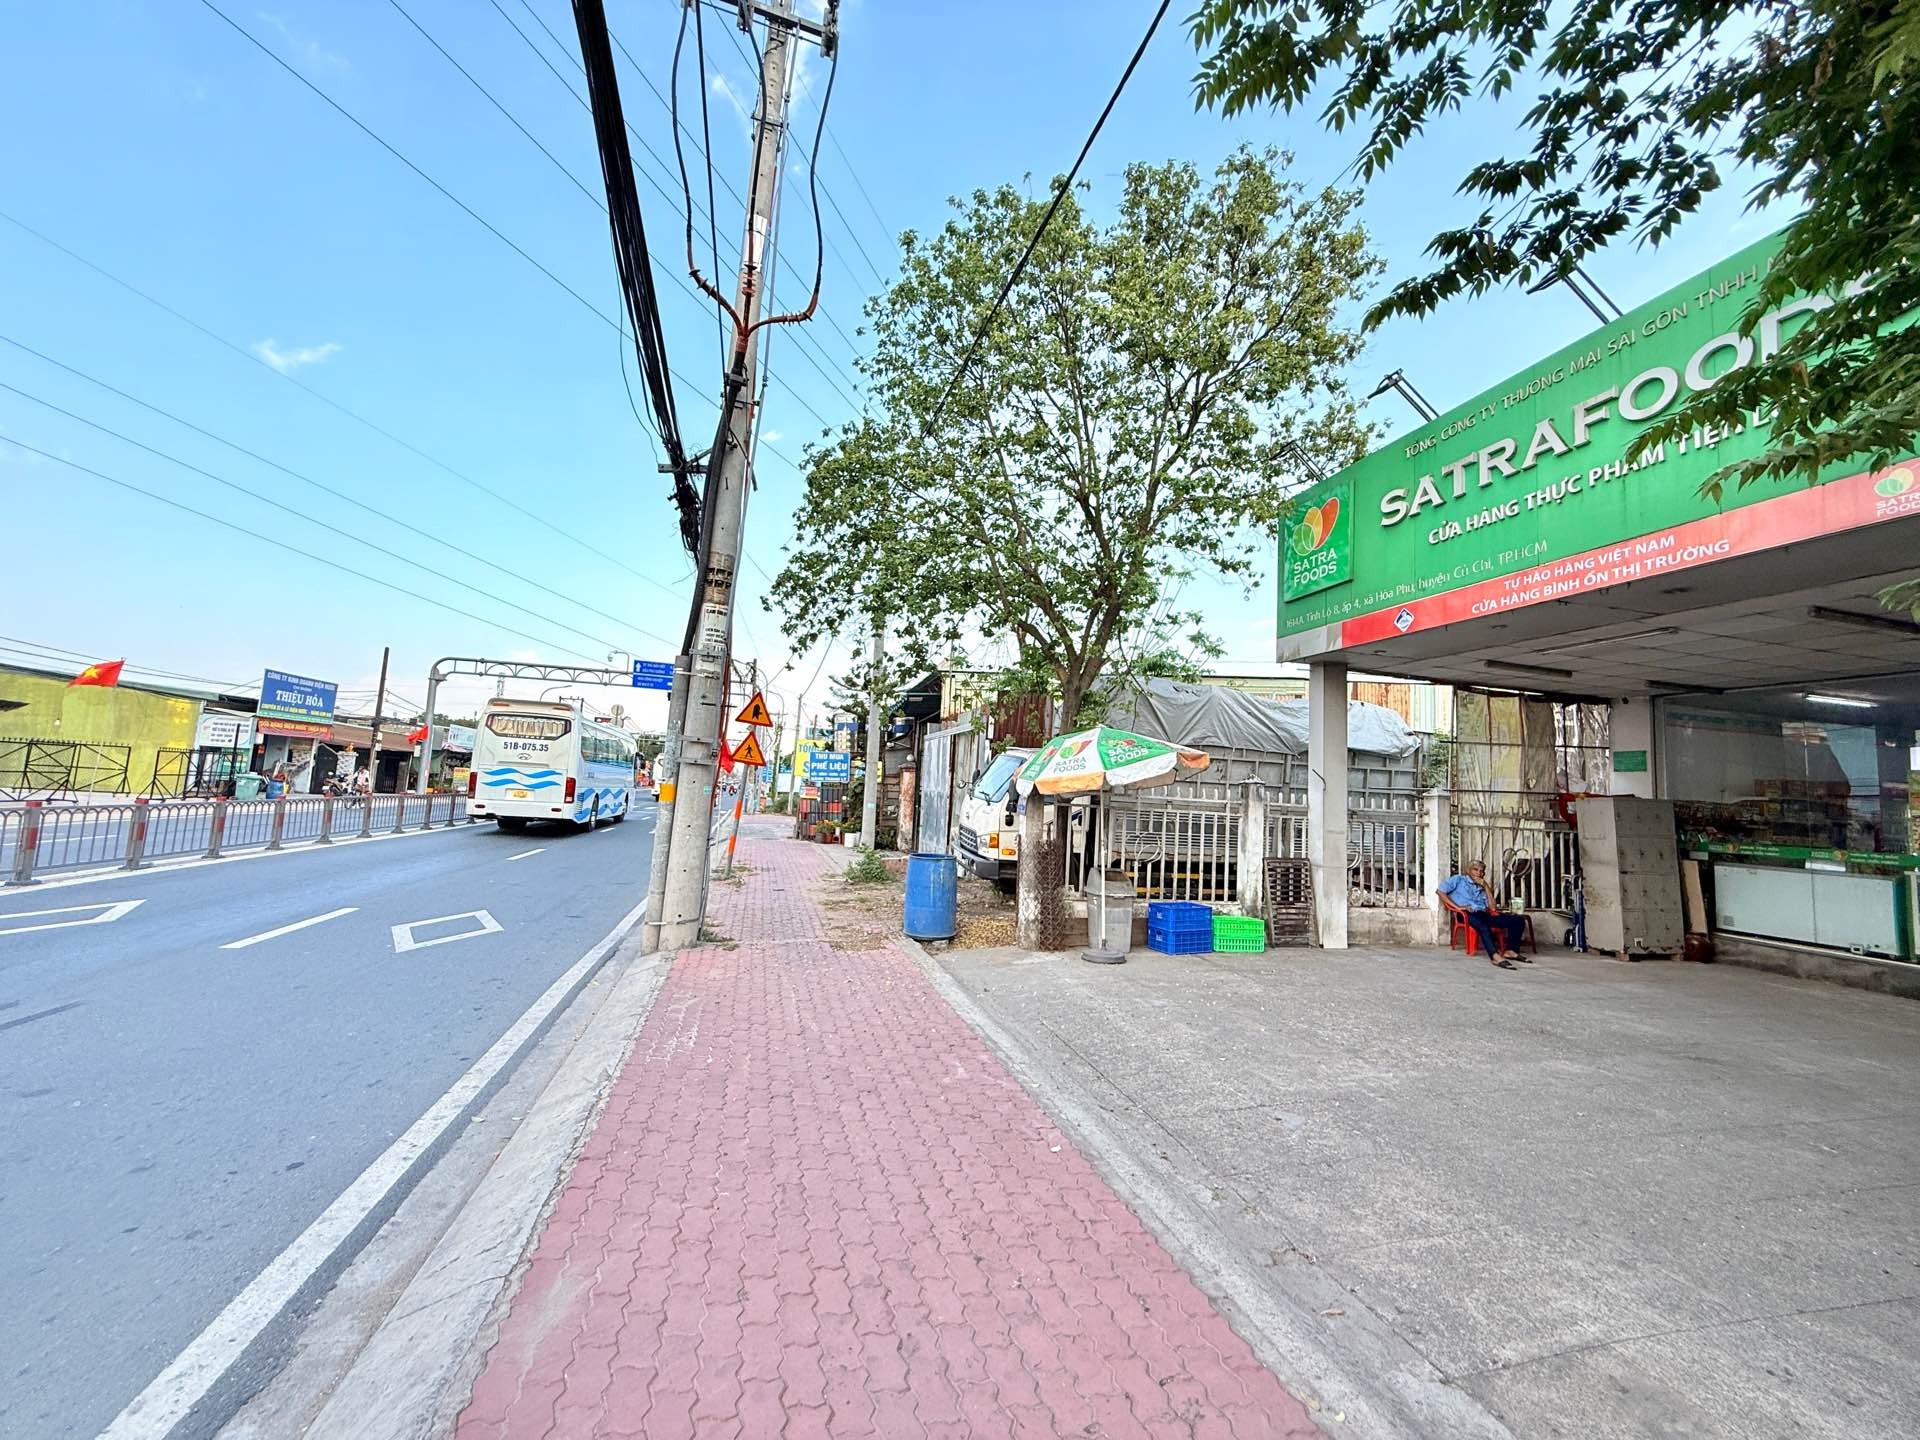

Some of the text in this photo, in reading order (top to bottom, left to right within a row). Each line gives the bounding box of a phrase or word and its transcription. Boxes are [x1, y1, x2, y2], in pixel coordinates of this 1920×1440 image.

[1480, 401, 1498, 420] TY
[1569, 347, 1603, 375] MẠI
[1695, 264, 1758, 310] TNHH
[1379, 265, 1885, 527] SATRAFOO
[1428, 520, 1463, 545] CỬA
[1465, 499, 1520, 533] HÀNG
[1523, 474, 1583, 511] THỰC
[1292, 561, 1338, 588] FOODS
[1293, 547, 1338, 574] SATRA
[1471, 597, 1498, 614] CỬA
[1500, 586, 1541, 608] HÀNG
[1543, 576, 1580, 598] BÌNH
[1611, 562, 1641, 579] THỊ
[1643, 539, 1731, 571] TRƯỜNG
[1504, 534, 1676, 591] TỰ HÀO HÀNG VIỆT NAM
[503, 741, 549, 752] 51B-075.35
[811, 760, 829, 771] PHẾ
[1053, 763, 1087, 775] FOODS
